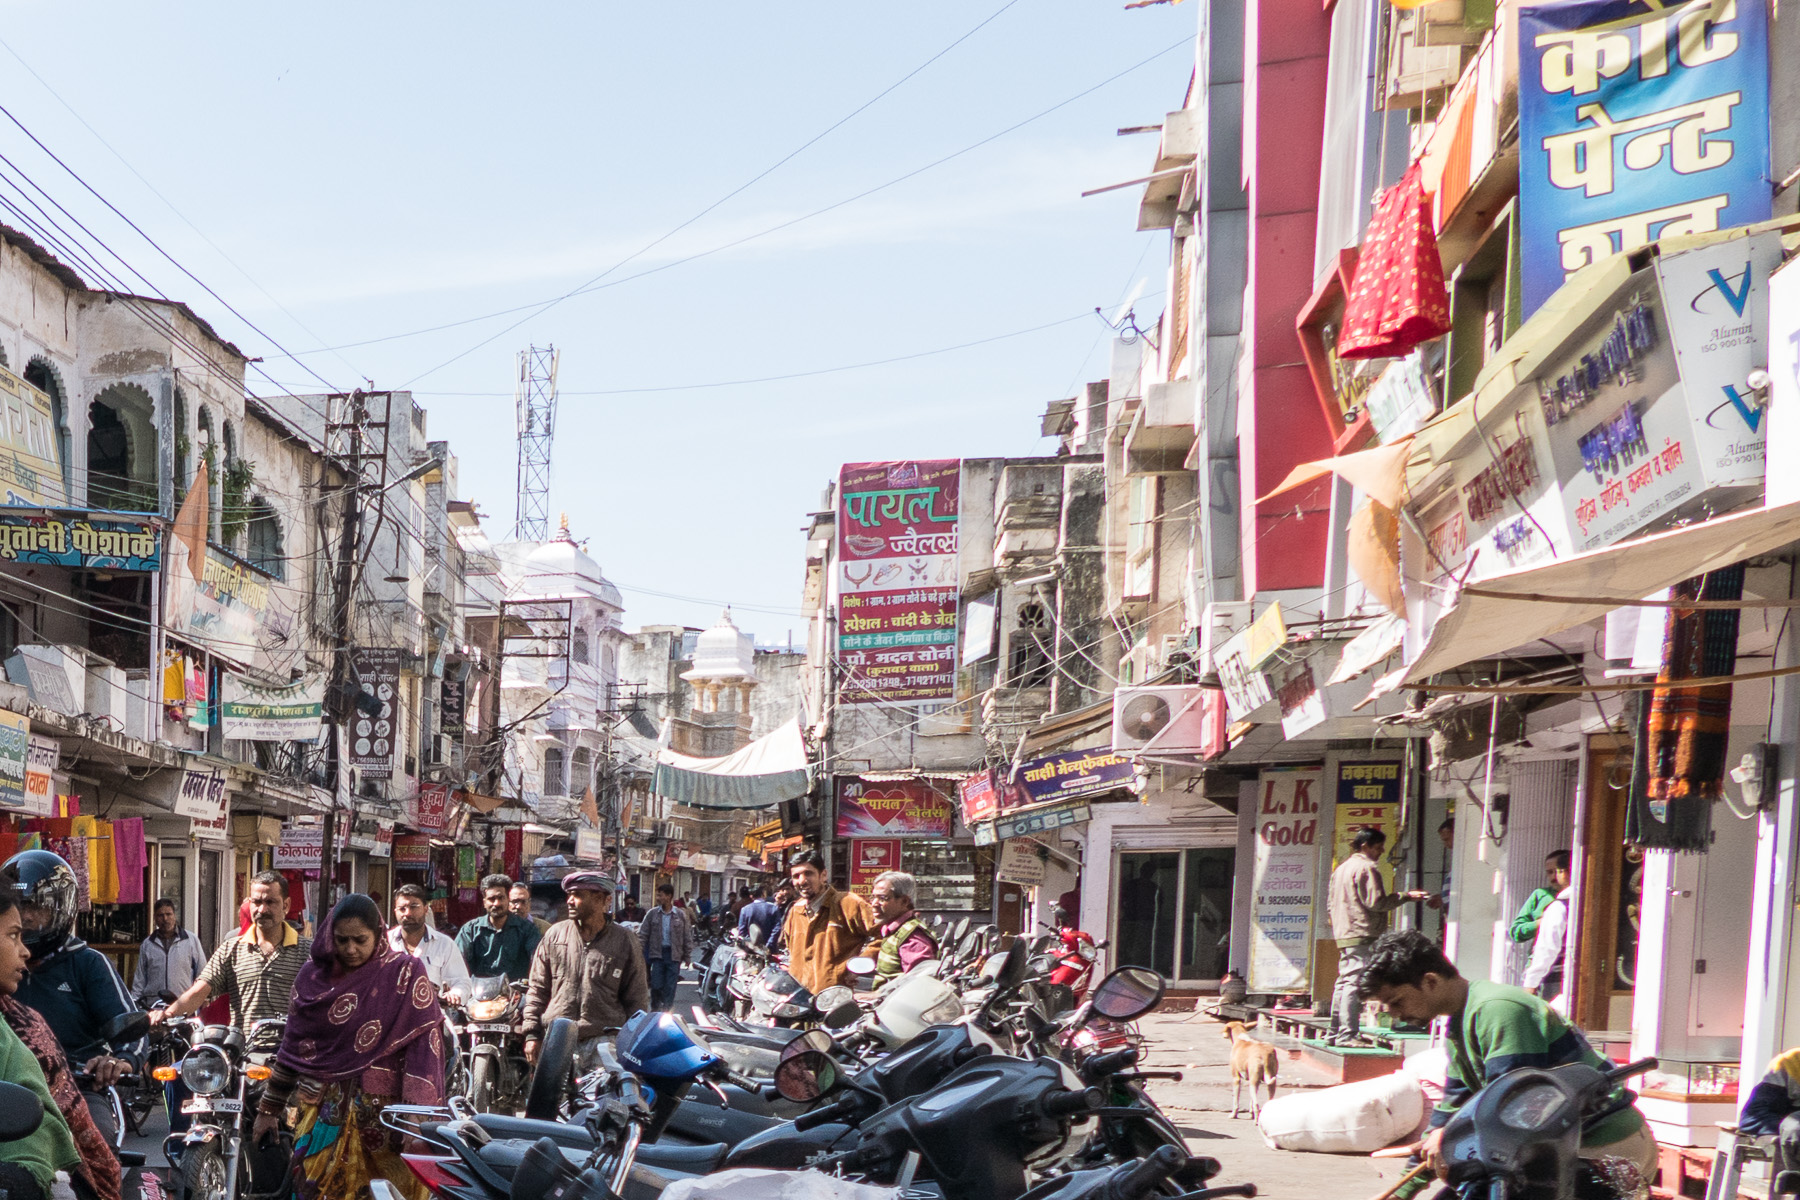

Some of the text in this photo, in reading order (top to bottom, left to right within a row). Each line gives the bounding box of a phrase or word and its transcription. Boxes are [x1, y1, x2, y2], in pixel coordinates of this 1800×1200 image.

[843, 486, 958, 528] पायल
[875, 652, 915, 665] मदन
[1023, 762, 1056, 783] साक्षी
[1261, 779, 1319, 815] L. K.
[1353, 785, 1385, 800] वाला
[1260, 819, 1318, 846] Gold
